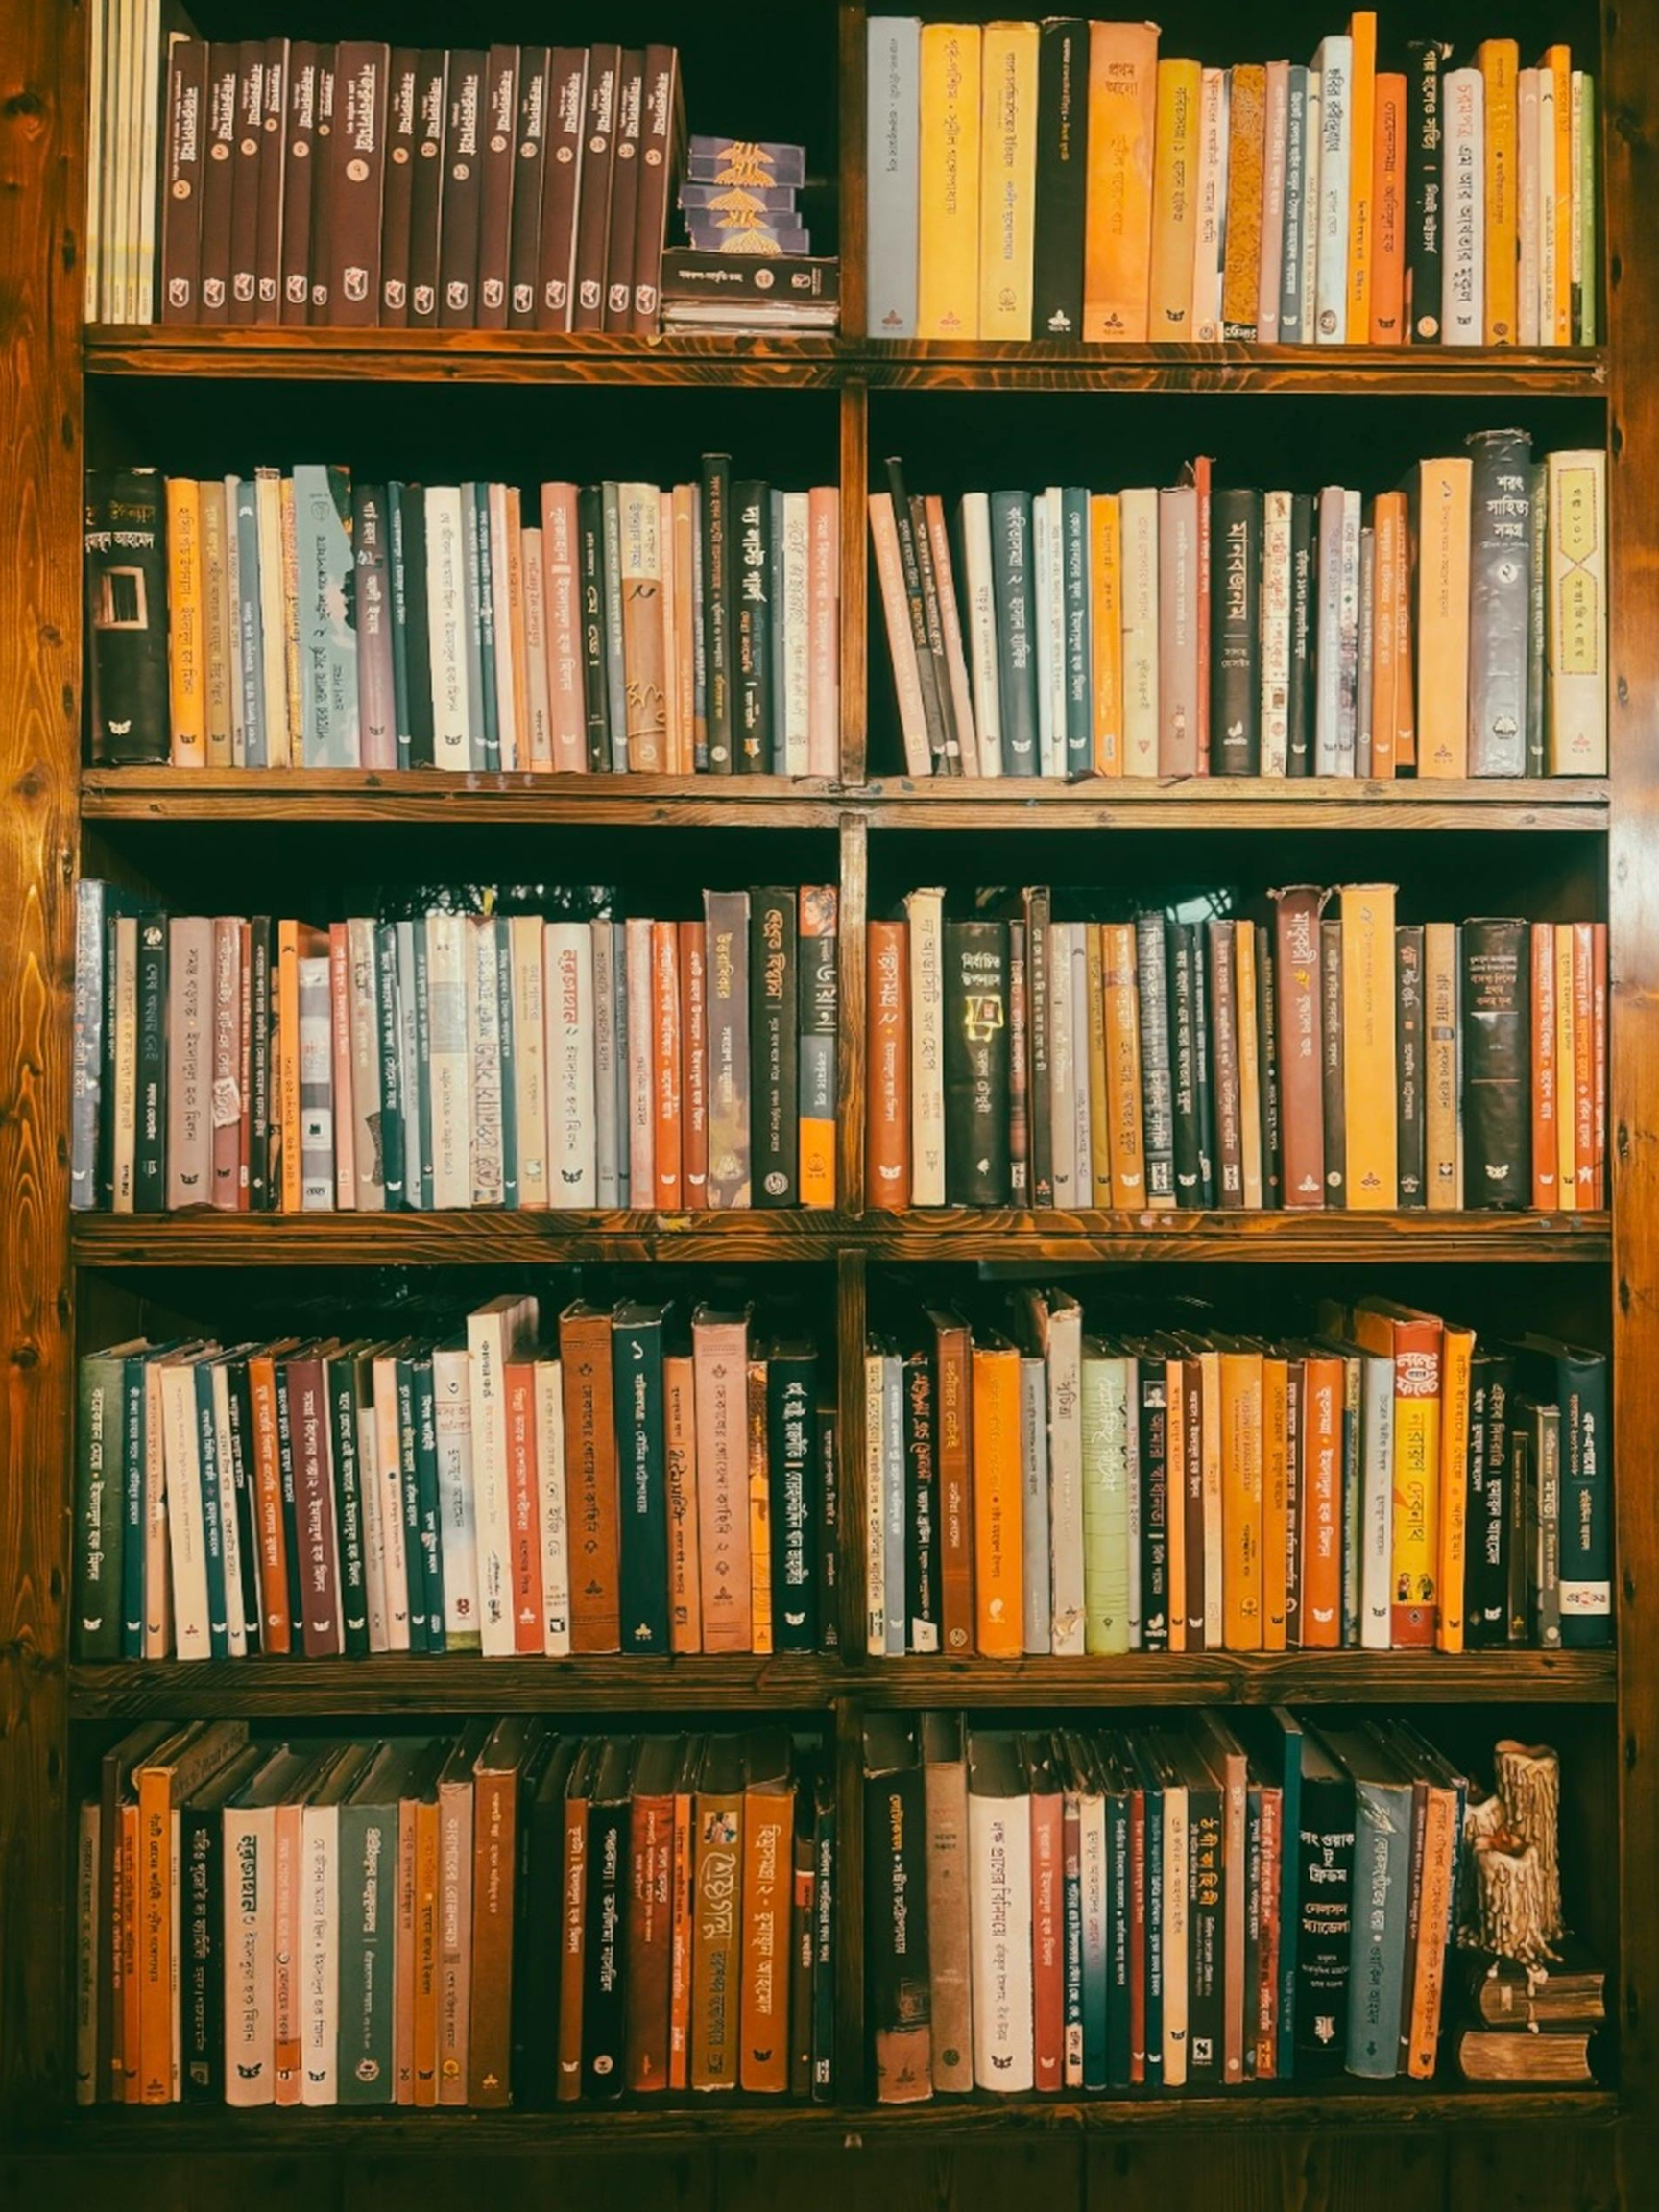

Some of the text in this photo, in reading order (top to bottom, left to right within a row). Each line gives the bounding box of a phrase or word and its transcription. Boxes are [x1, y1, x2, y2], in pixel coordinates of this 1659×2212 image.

[180, 87, 198, 161] নজরুলসমগ্র
[354, 64, 376, 153] নজরুলসমগ্র
[457, 75, 479, 156] নজরুলসমগ্র
[1457, 145, 1474, 166] এম
[1455, 172, 1473, 199] আর
[1455, 205, 1473, 261] আখতার
[1453, 268, 1473, 302] মুকুল
[1226, 521, 1248, 620] মানবজনম
[1286, 911, 1316, 964] মাধুকরী
[1317, 1449, 1334, 1499] ইমদাদুল
[1406, 1413, 1427, 1542] নারায়ণ দেবনাথ
[1319, 1503, 1332, 1523] হক
[1318, 1526, 1334, 1558] মিলন
[238, 1835, 258, 1912] নূরজাহান
[992, 1888, 1010, 1937] বিনিময়ে
[756, 1960, 774, 2014] আহমেদ
